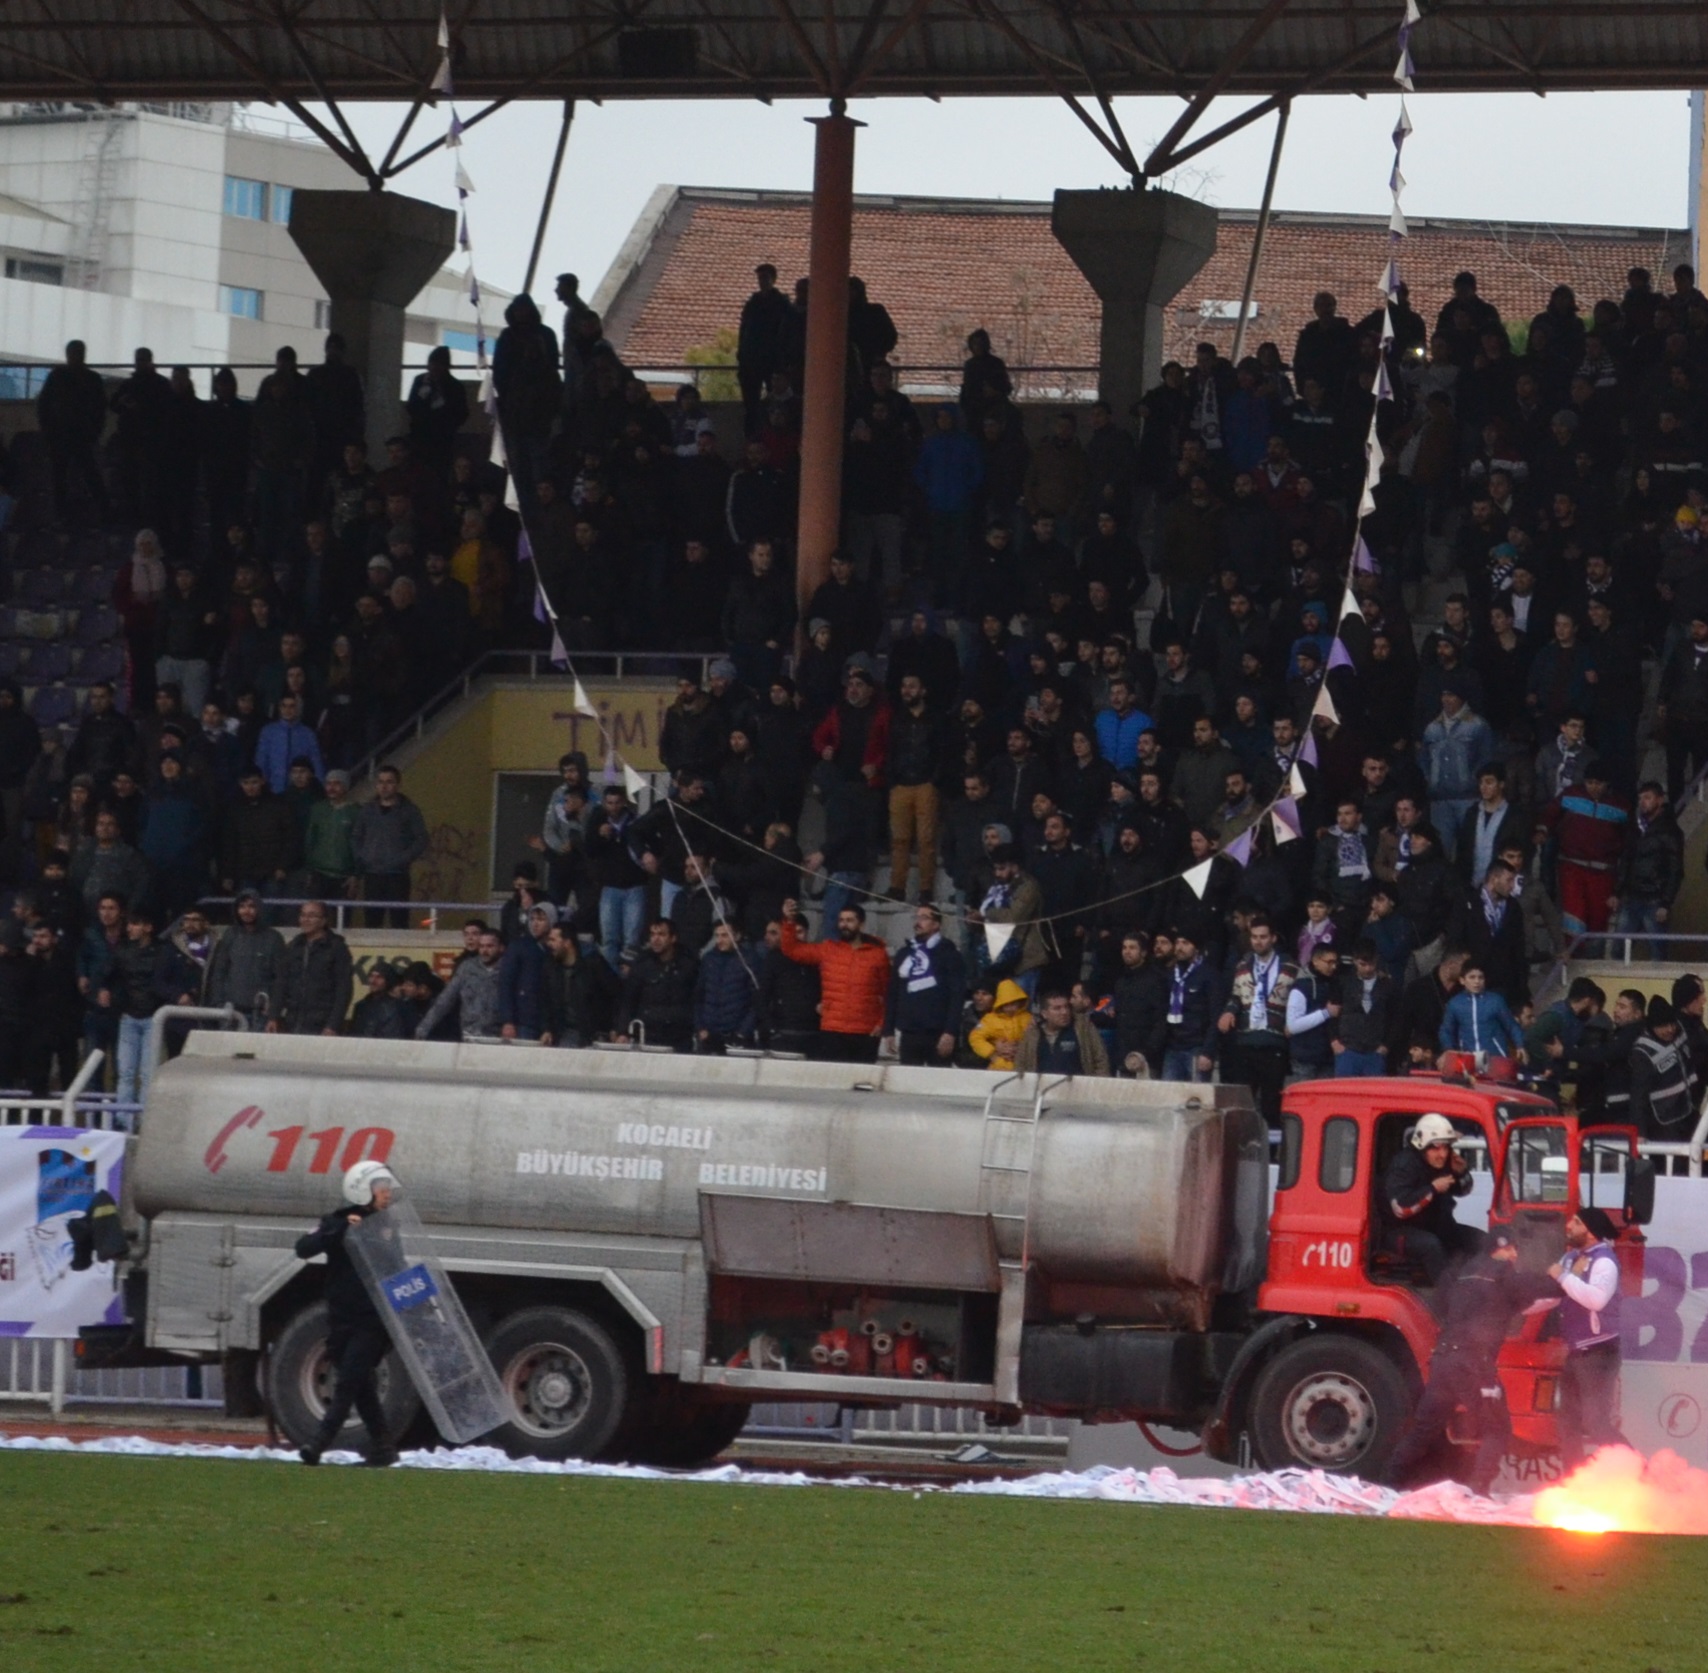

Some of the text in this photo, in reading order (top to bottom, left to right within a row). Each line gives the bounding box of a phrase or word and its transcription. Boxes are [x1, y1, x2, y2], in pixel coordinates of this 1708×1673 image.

[266, 1125, 396, 1174] 110
[616, 1122, 714, 1150] KOCAELİ
[516, 1150, 828, 1192] BÜYÜKŞEHİR BELEDİYESİ
[1317, 1240, 1352, 1269] 110
